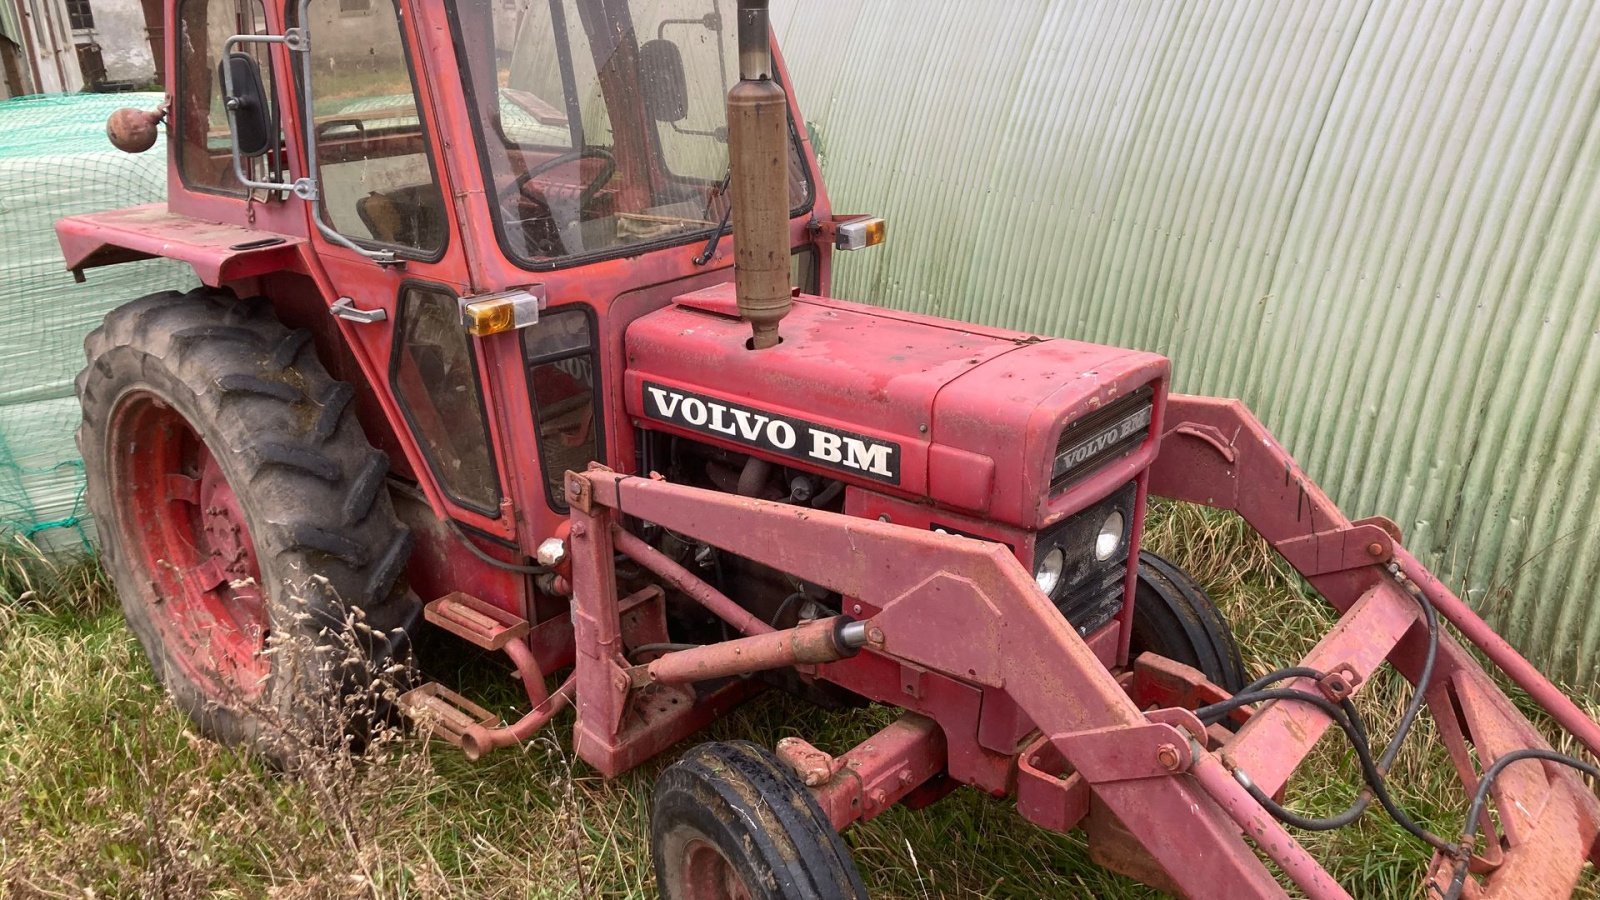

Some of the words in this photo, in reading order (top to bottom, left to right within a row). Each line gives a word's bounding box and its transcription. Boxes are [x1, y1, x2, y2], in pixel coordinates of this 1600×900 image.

[648, 386, 797, 450] VOLVO
[808, 428, 893, 477] BM
[1063, 429, 1118, 468] VOLVO
[1120, 411, 1147, 439] BM
